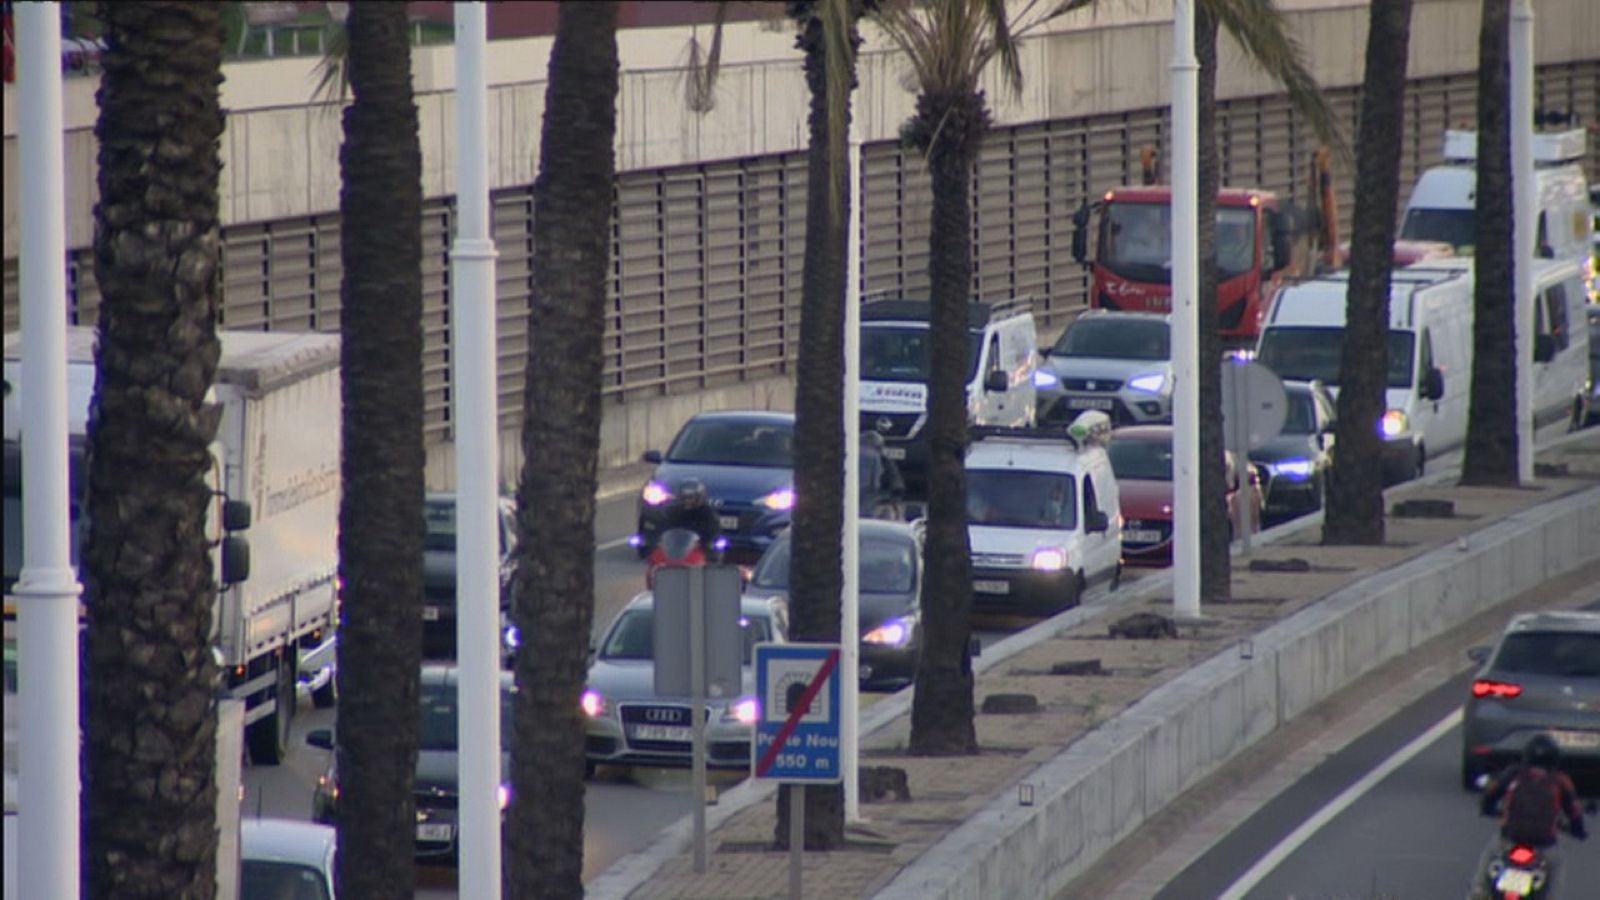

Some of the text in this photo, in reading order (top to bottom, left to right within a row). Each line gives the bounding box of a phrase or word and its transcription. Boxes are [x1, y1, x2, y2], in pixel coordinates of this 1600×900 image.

[806, 733, 838, 748] Nou
[775, 753, 829, 769] 550 m
